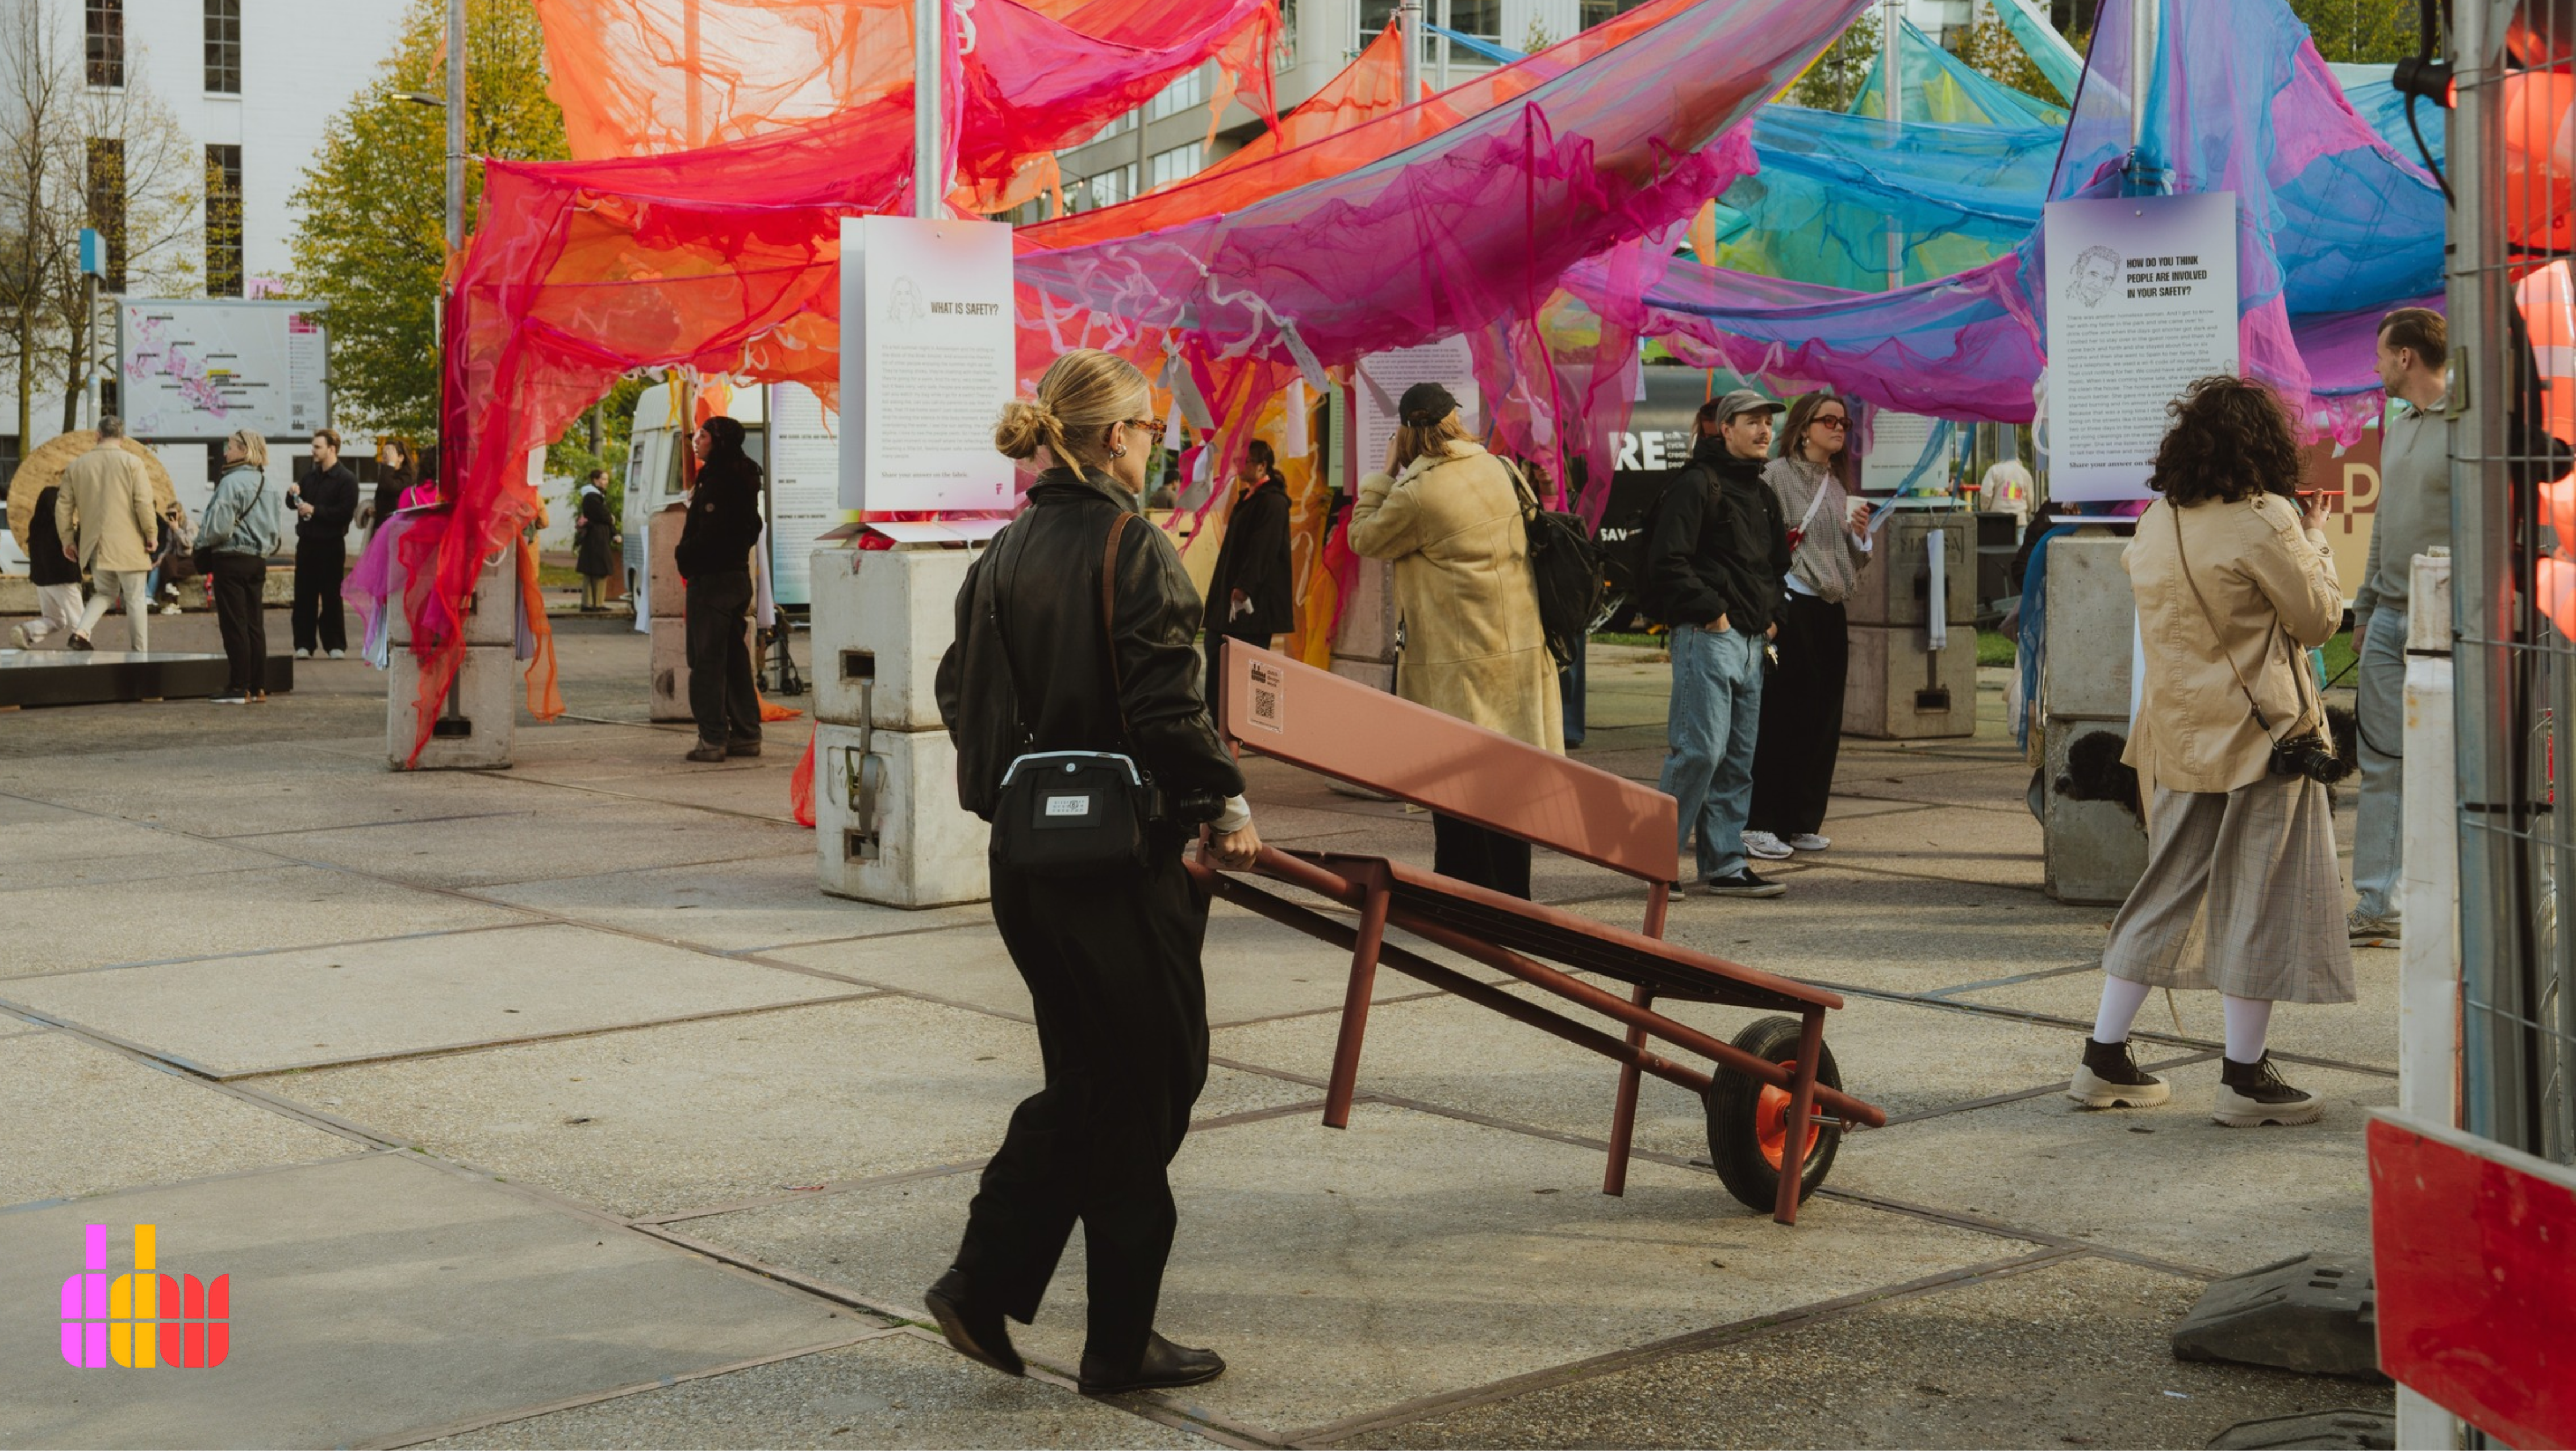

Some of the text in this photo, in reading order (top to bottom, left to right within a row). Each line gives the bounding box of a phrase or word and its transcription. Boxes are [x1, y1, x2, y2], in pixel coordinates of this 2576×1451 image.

[2127, 255, 2198, 269] HOW DO YOU THINK
[2127, 270, 2207, 283] PEOPLE ARE INVOLVED
[2127, 286, 2191, 299] IN YOUR SAFETY?
[930, 301, 999, 316] WHAT IS SAFETY?
[1609, 431, 1667, 470] RE
